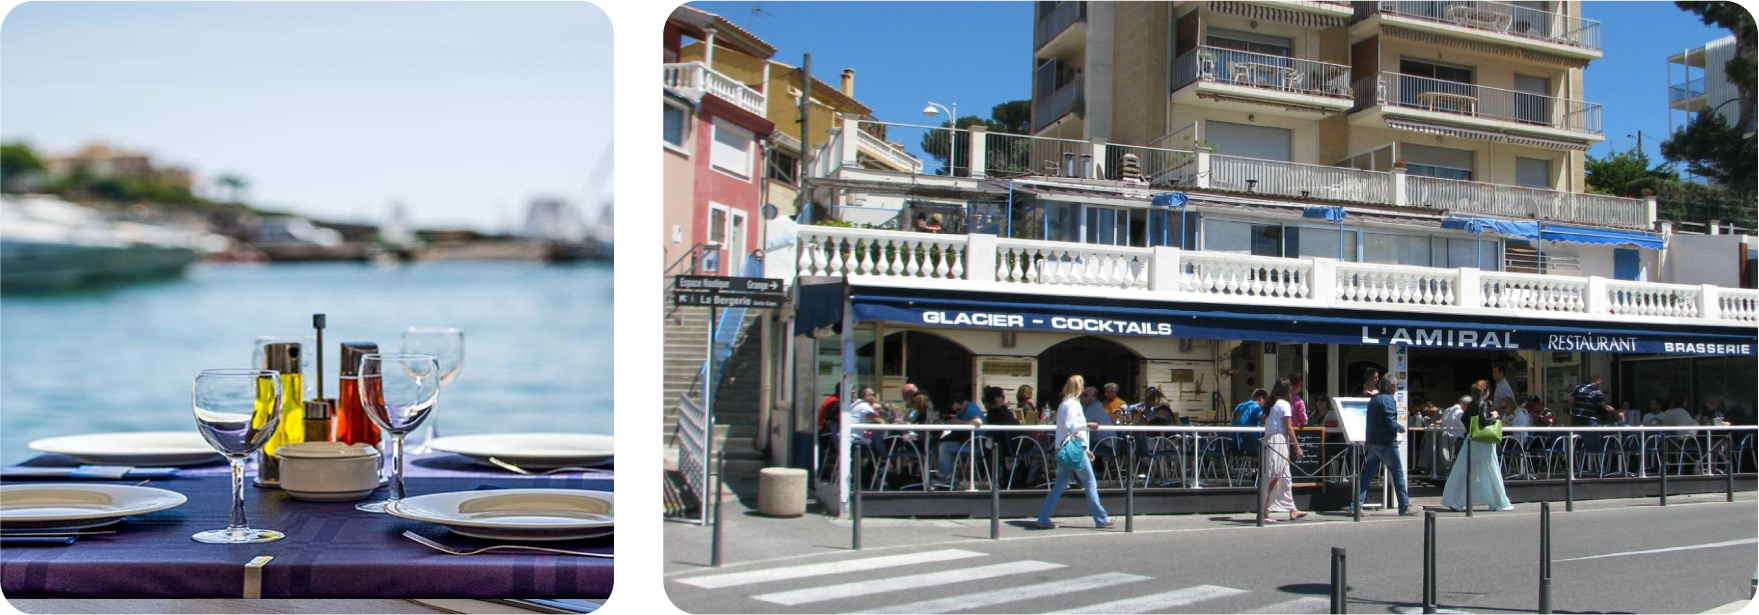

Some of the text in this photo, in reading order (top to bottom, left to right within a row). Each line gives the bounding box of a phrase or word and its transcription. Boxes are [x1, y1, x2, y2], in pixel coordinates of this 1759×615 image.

[680, 278, 701, 289] Espace
[703, 279, 730, 289] Nautique
[700, 295, 712, 304] La
[714, 295, 752, 306] Bergerie
[923, 311, 1024, 327] GLACIER
[1051, 316, 1172, 335] COCKTAILS
[1362, 325, 1750, 354] L'AMIRAL RESTAURANT BRASSERIE
